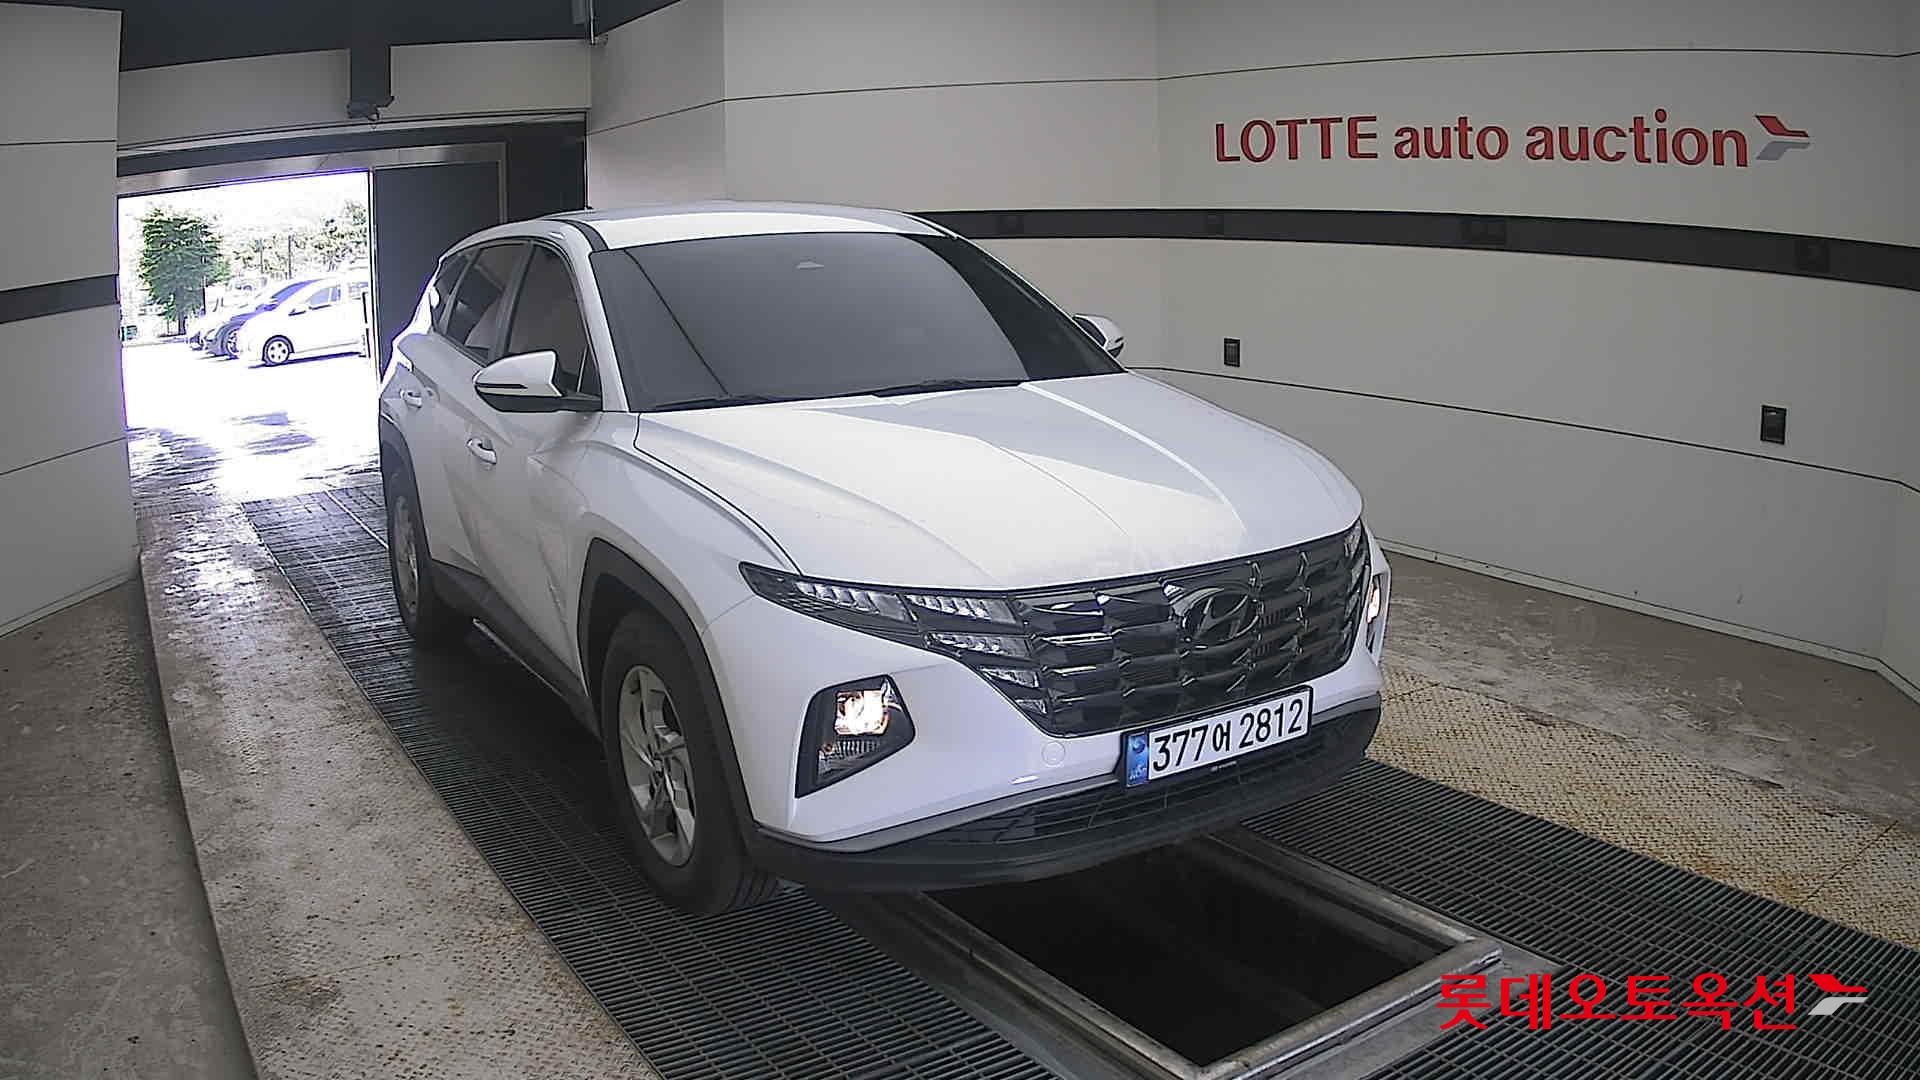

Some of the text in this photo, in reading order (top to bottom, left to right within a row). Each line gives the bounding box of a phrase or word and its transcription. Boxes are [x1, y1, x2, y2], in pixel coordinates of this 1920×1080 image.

[1215, 109, 1748, 167] LOTTE auto auction
[1153, 699, 1304, 772] 377어 2812
